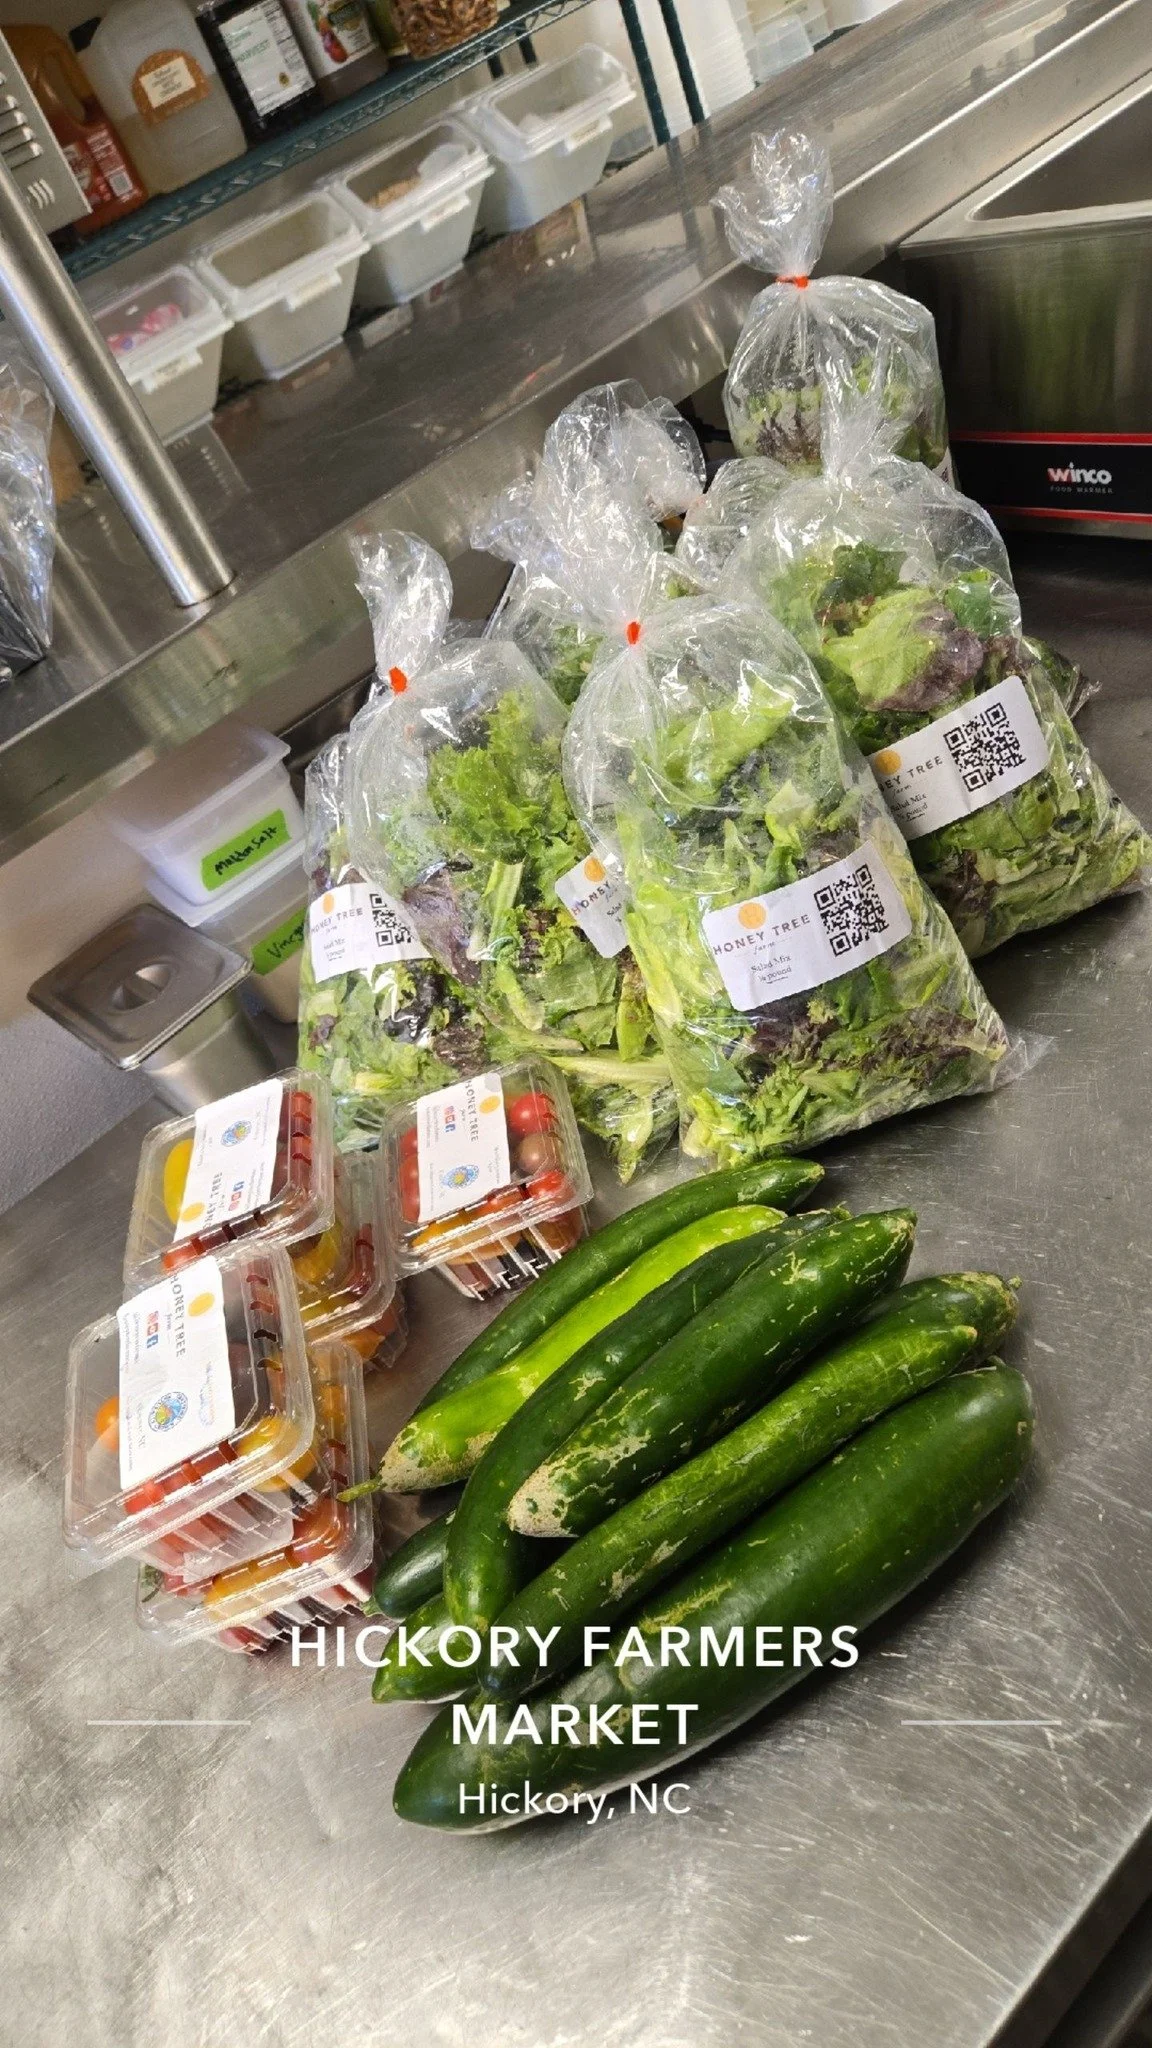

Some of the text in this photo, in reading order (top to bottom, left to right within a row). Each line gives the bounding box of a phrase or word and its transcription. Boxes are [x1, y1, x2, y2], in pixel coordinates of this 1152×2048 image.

[1047, 461, 1113, 485] winco
[907, 755, 944, 779] TREE
[251, 826, 278, 850] Salt
[712, 914, 811, 956] HONEY TREE
[173, 1321, 187, 1359] TREE
